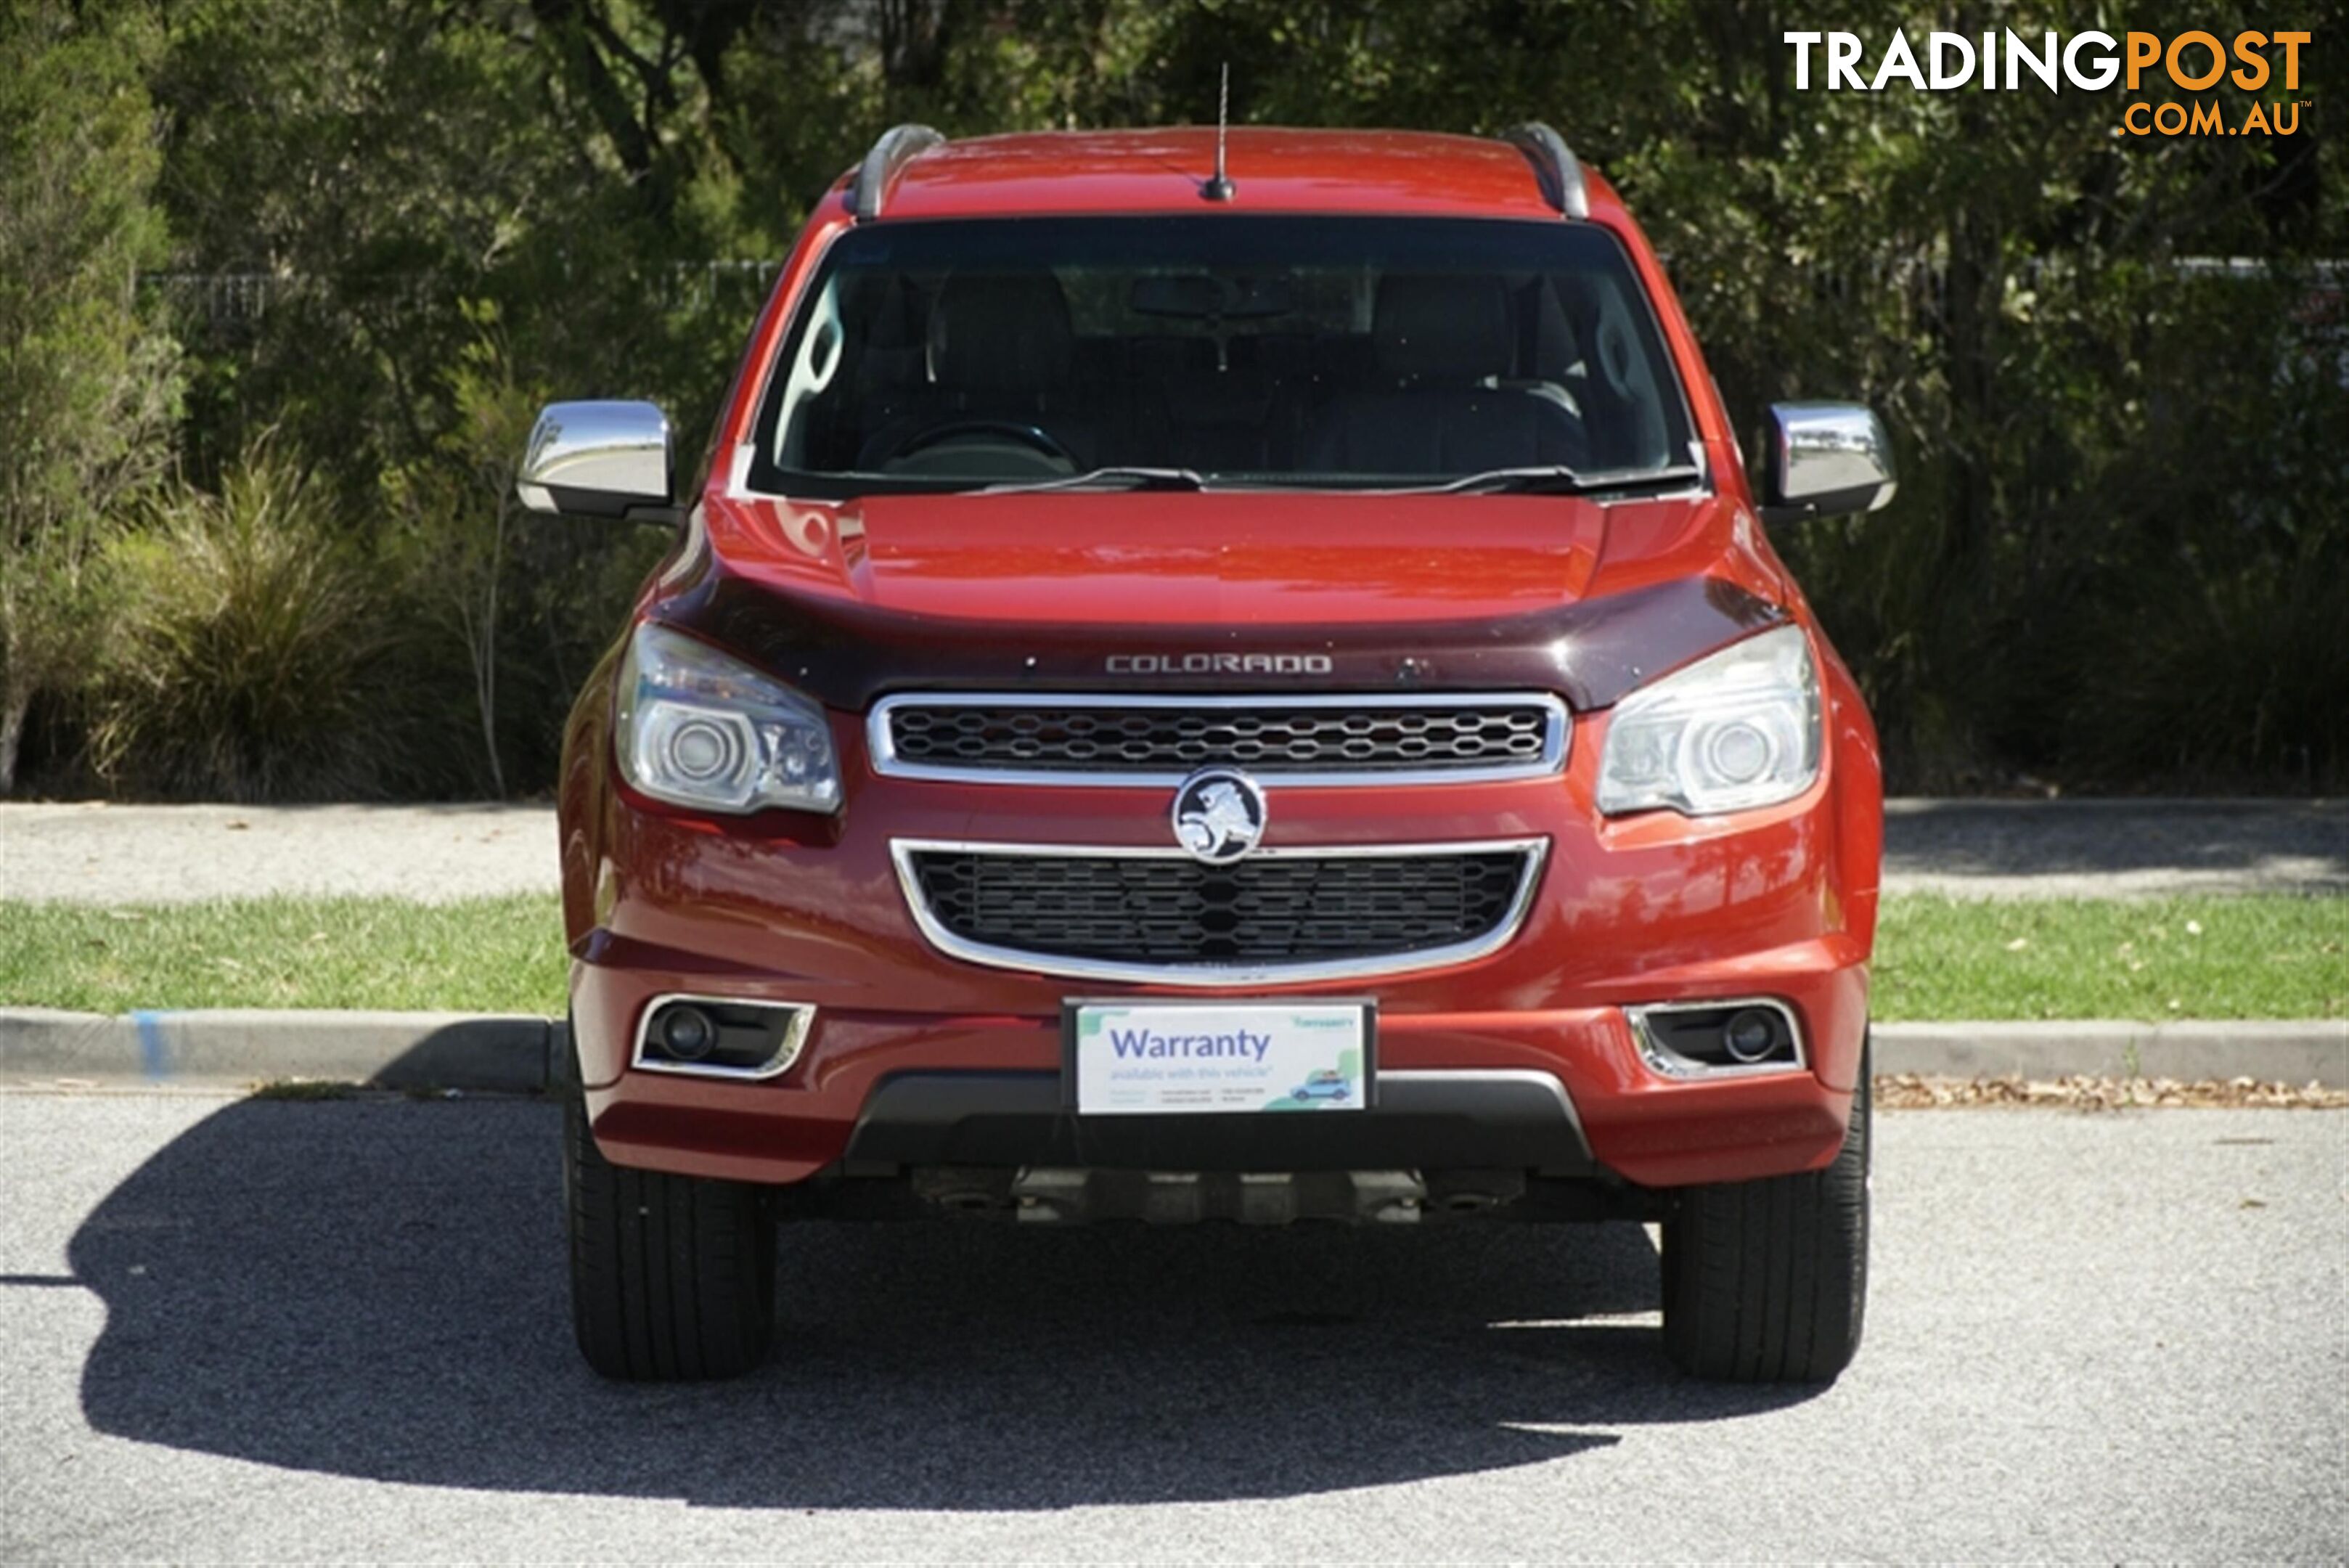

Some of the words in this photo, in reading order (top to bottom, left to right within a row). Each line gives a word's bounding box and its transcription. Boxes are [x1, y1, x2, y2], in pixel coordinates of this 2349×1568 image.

[1105, 653, 1333, 674] COLORADO
[1110, 1029, 1271, 1061] Warranty
[1111, 1067, 1164, 1081] available
[1167, 1066, 1196, 1079] with
[1198, 1066, 1221, 1079] this
